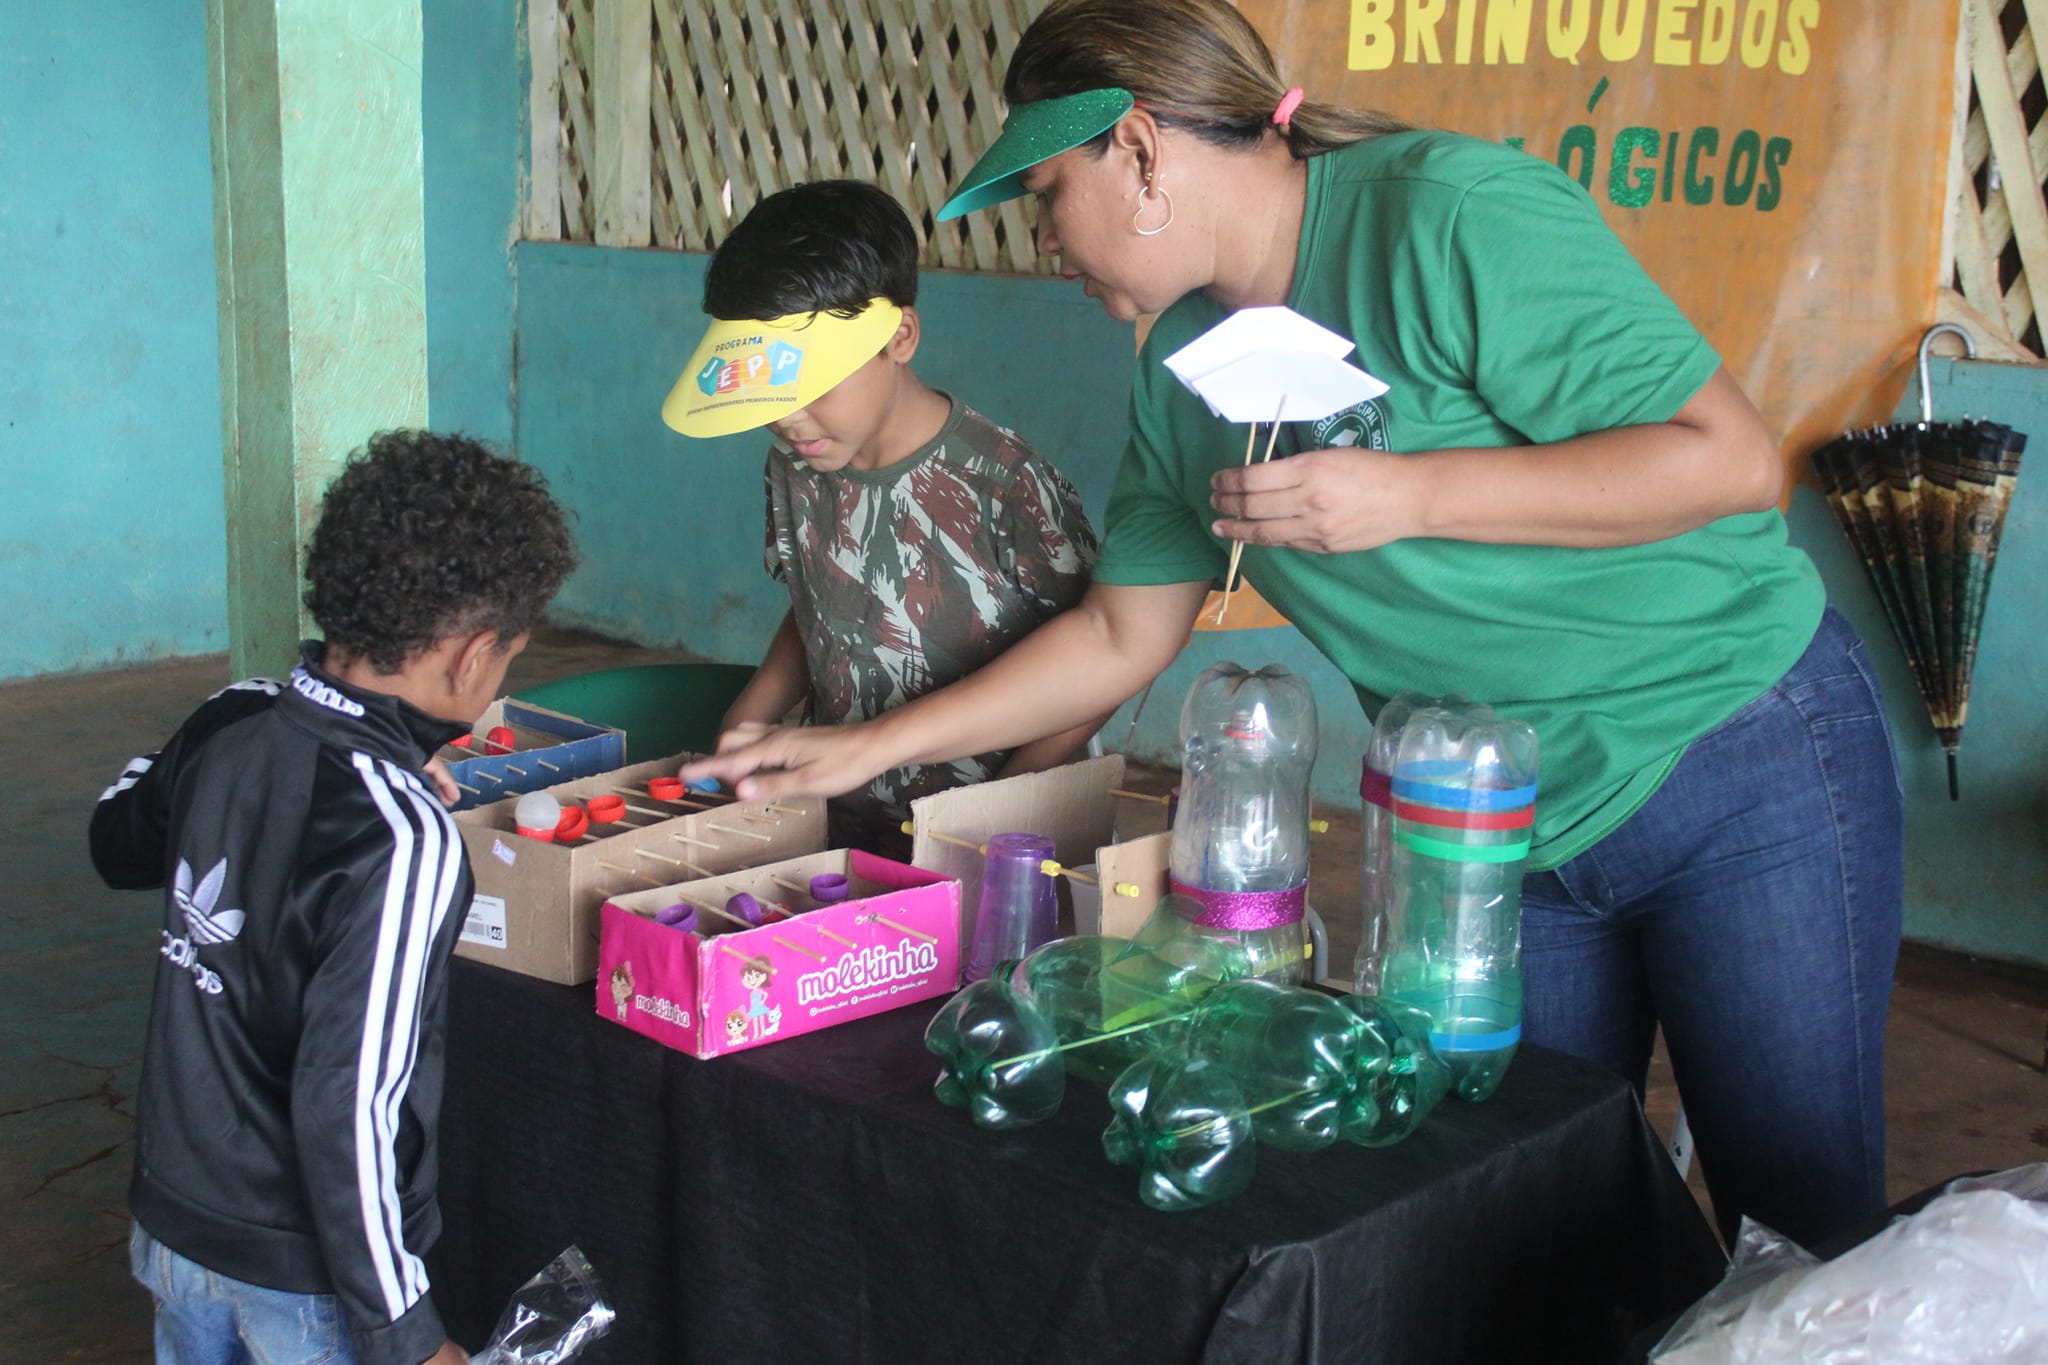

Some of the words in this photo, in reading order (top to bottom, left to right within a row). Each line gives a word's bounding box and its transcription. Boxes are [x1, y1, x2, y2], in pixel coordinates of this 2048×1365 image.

[1347, 0, 1820, 75] BRINQUEDOS
[1505, 77, 1792, 212] ÓGICOS
[701, 350, 797, 389] JEPP
[714, 335, 764, 353] PROGRAMA
[797, 938, 938, 1006] molekinha
[635, 993, 691, 1029] molekinha
